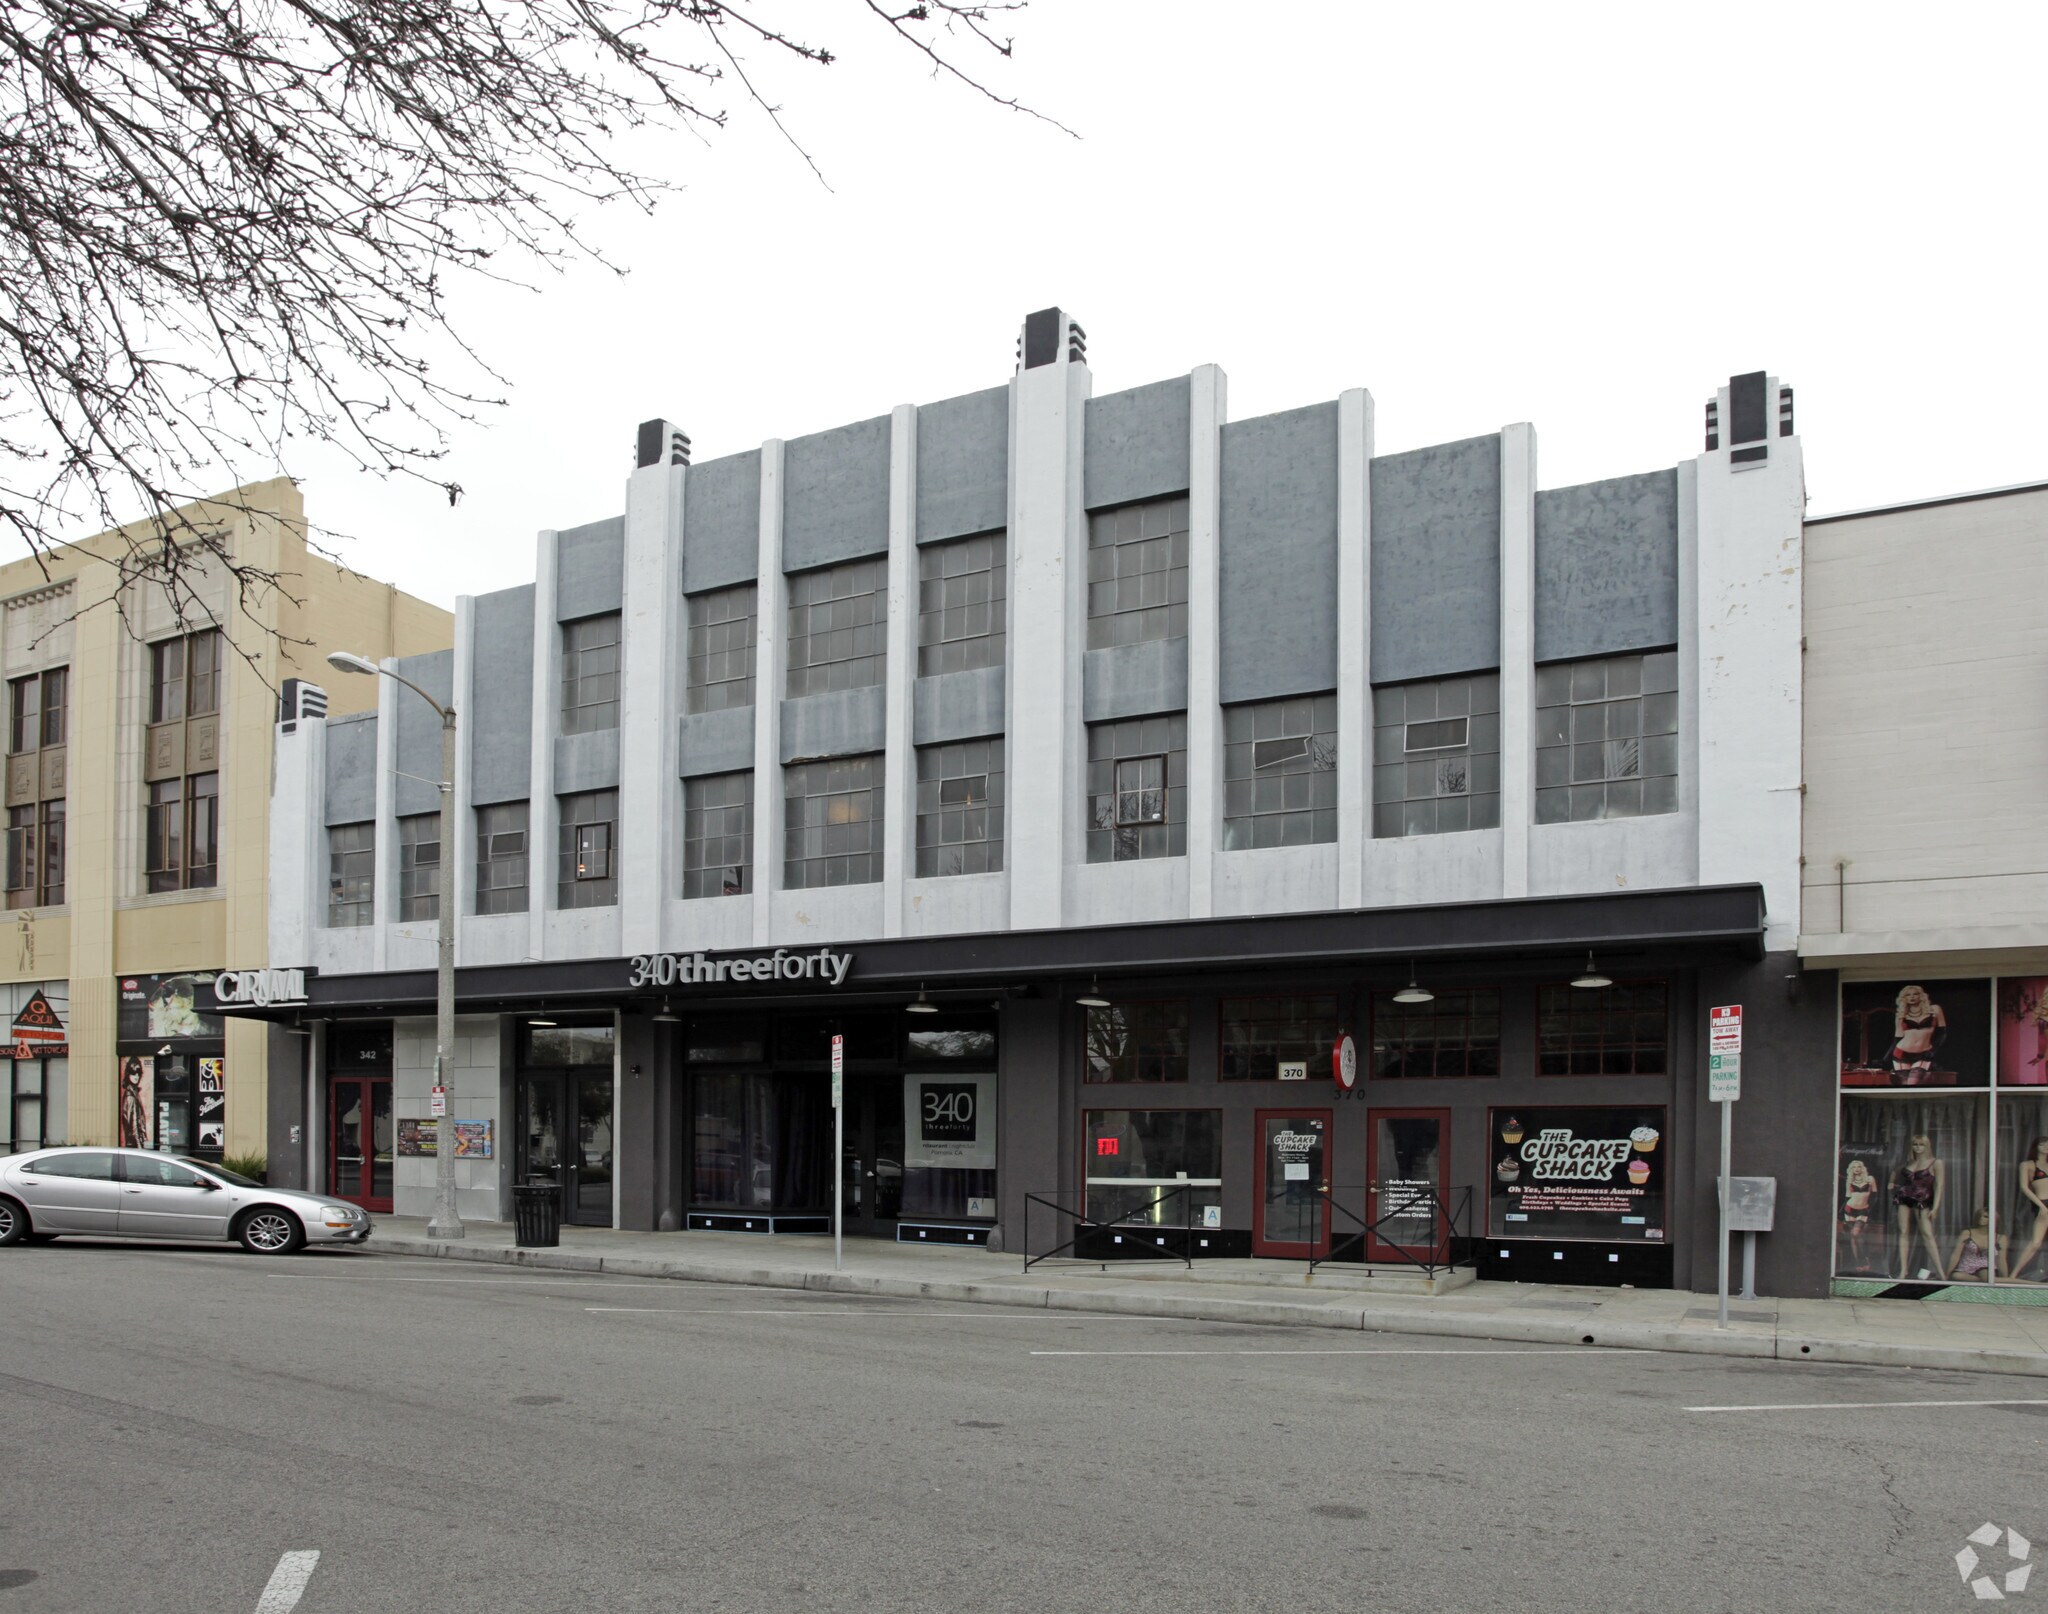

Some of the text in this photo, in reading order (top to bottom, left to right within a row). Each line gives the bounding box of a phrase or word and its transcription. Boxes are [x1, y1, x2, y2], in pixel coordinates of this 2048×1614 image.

[215, 969, 309, 1007] CARNAVAL
[29, 1000, 46, 1014] Q
[1721, 1008, 1731, 1017] NO
[20, 1013, 52, 1024] AQUI
[1713, 1016, 1740, 1027] PARKING
[359, 1050, 376, 1060] 342
[1712, 1057, 1737, 1068] 2 HOUR
[1283, 1068, 1303, 1078] 370
[1712, 1071, 1737, 1081] PARKING
[1333, 1089, 1366, 1101] 370
[924, 1092, 973, 1122] 340
[925, 1123, 971, 1131] threeforty
[1274, 1135, 1316, 1145] CUPCAKE
[1544, 1132, 1568, 1142] THE
[1279, 1143, 1309, 1151] SHACK
[1523, 1142, 1628, 1160] CUPCAKE
[1536, 1160, 1611, 1178] SHACK
[1523, 1186, 1541, 1194] Yes,
[1543, 1186, 1609, 1194] Deliciousness
[1610, 1187, 1645, 1195] Awaits
[971, 1201, 979, 1210] A
[1208, 1210, 1218, 1220] A
